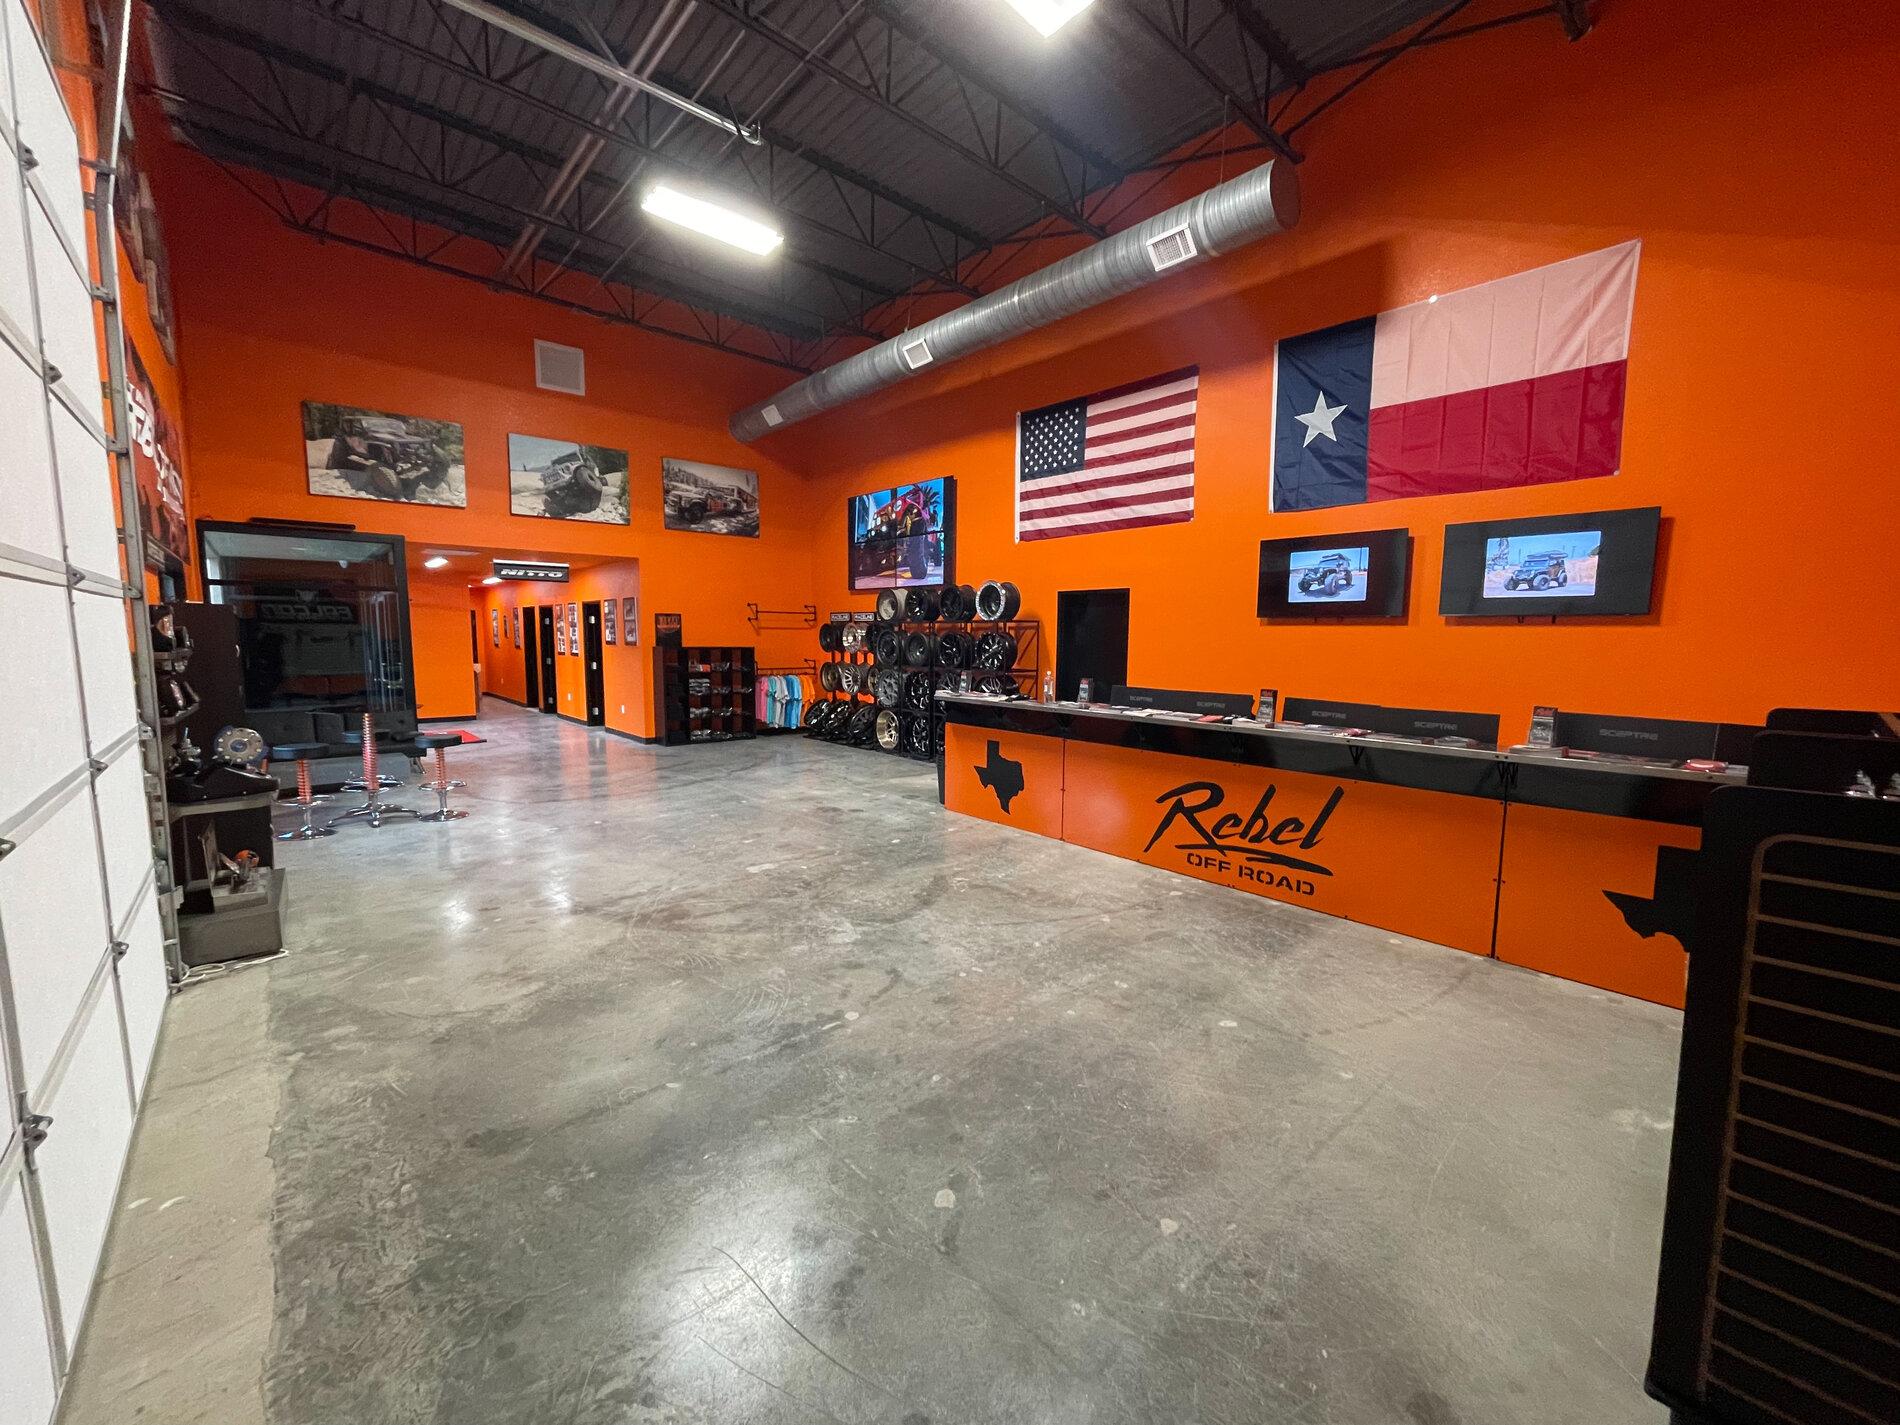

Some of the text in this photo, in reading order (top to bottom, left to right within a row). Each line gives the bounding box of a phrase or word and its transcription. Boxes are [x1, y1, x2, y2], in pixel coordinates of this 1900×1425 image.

[500, 568, 564, 578] NITTO
[1143, 781, 1345, 857] Rebel
[1186, 852, 1316, 897] OFF ROAD
